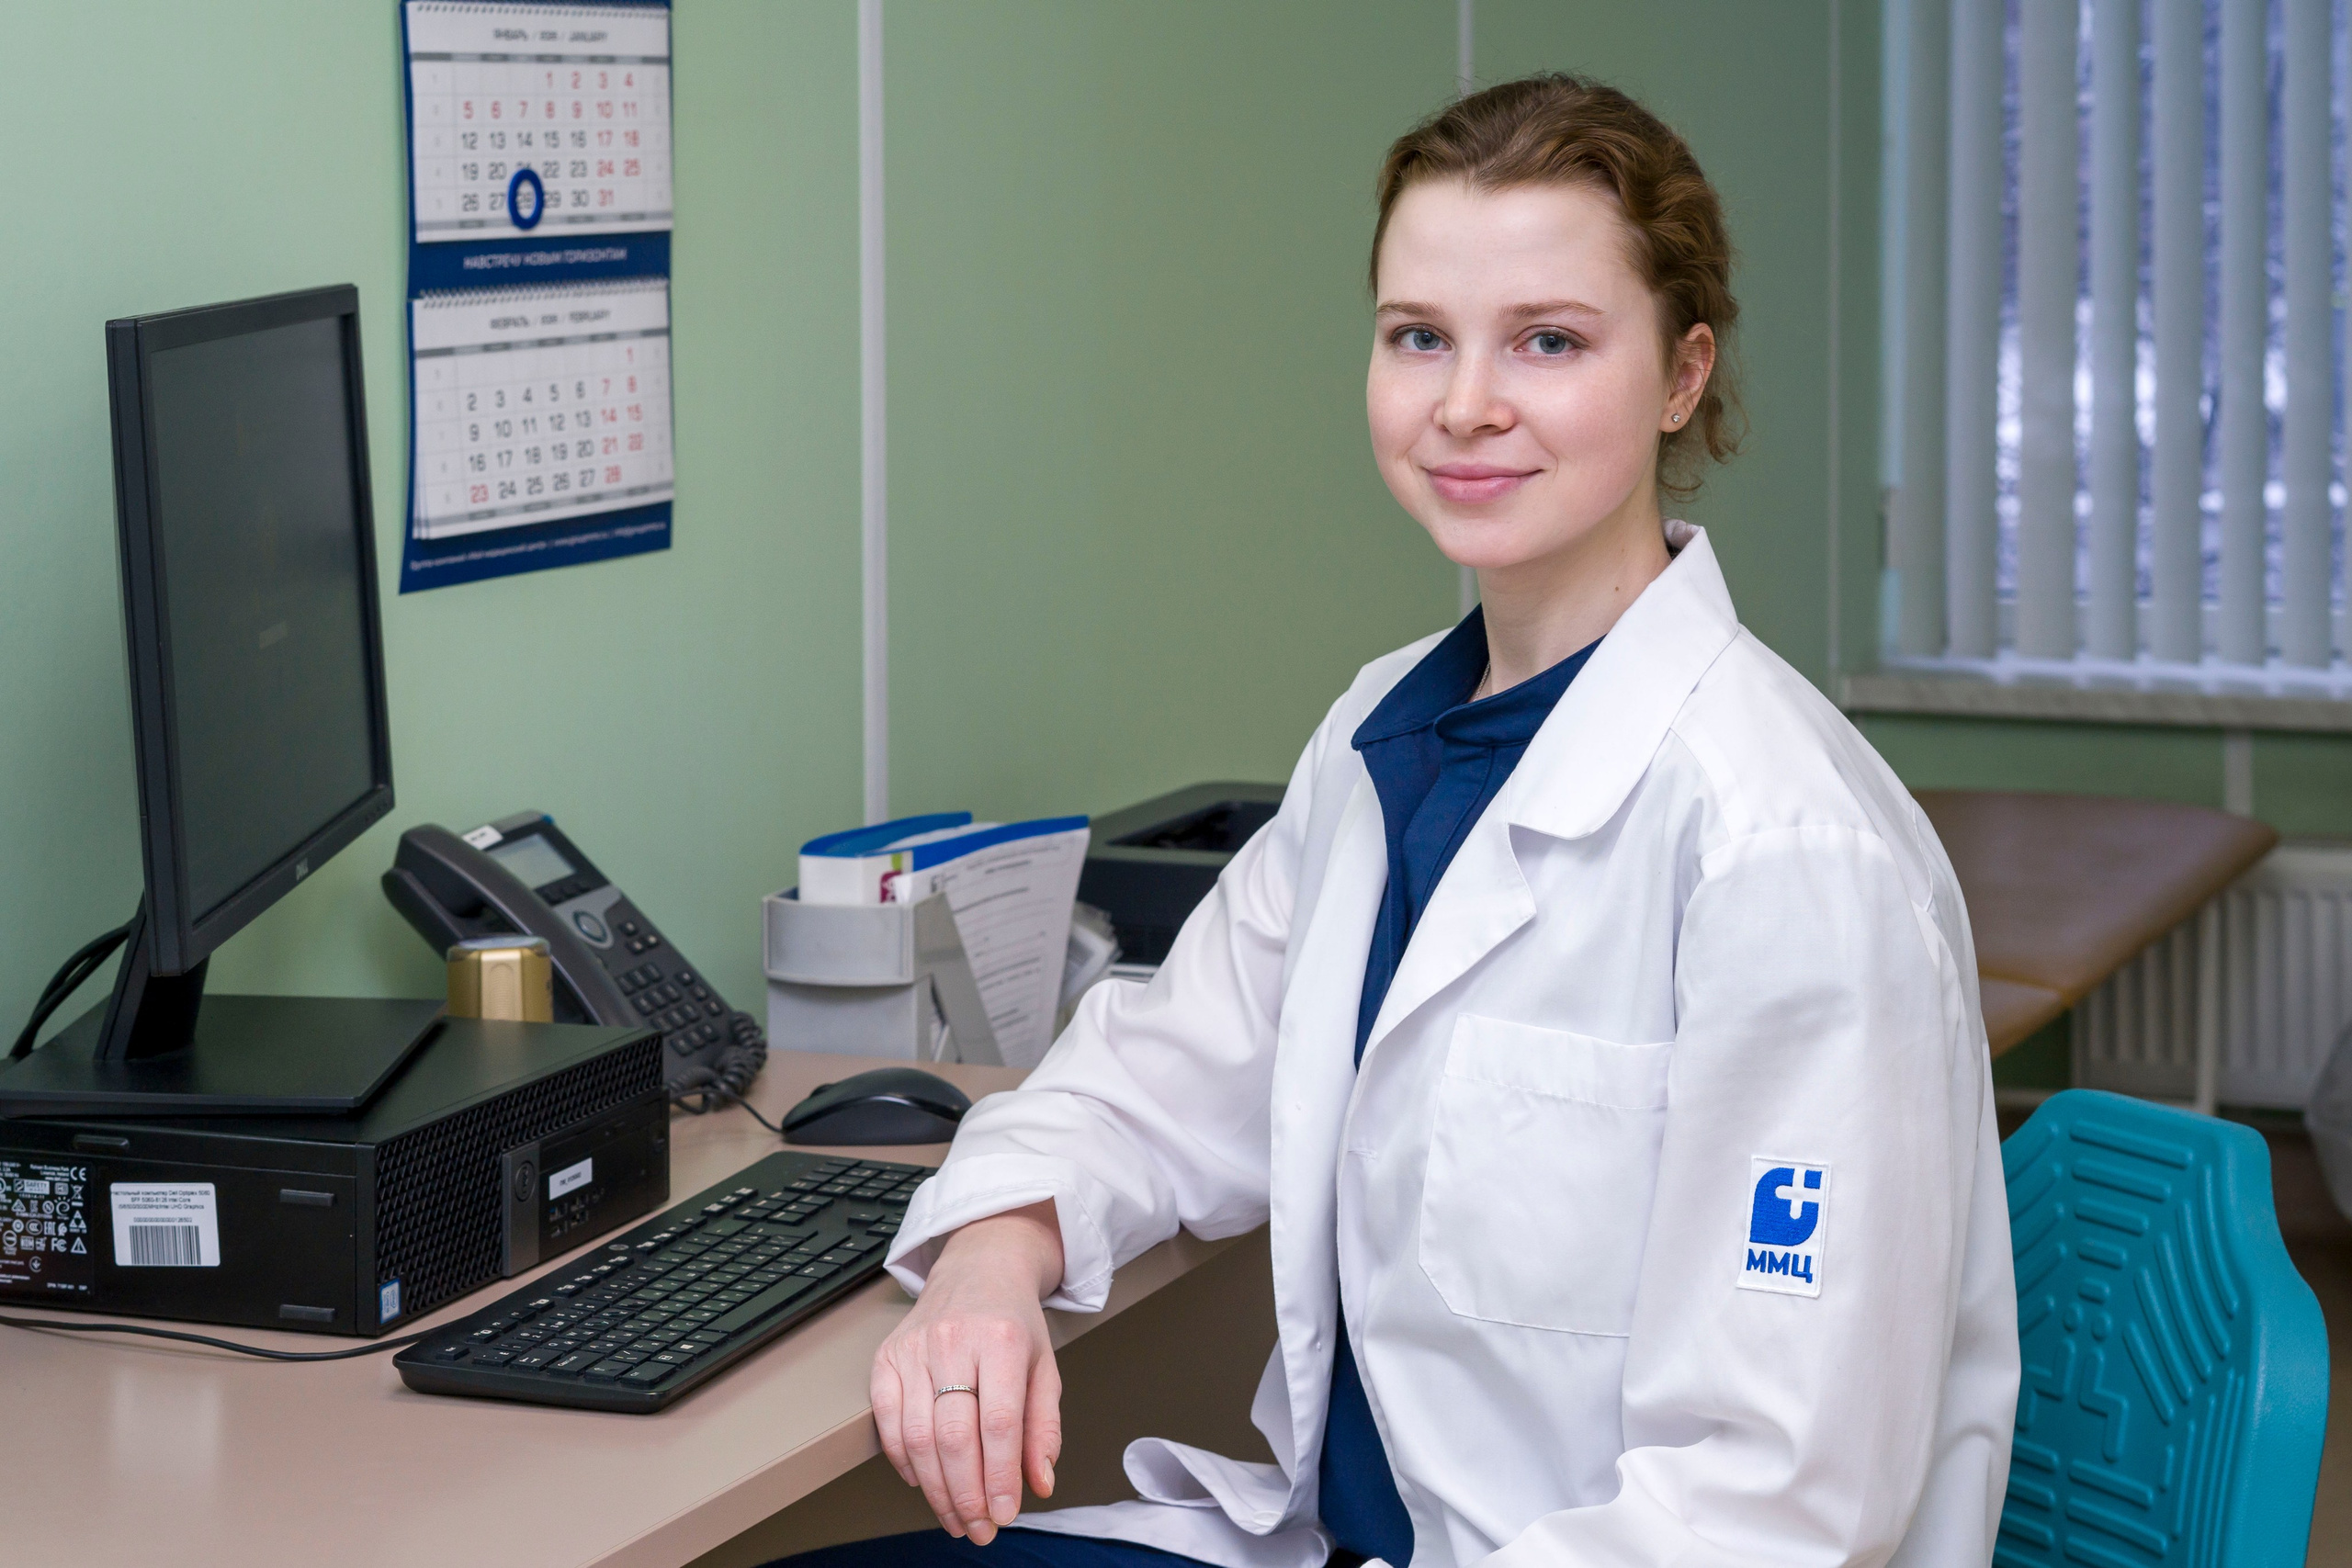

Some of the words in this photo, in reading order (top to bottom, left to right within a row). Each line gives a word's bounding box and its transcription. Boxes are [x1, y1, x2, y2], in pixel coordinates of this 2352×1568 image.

[546, 72, 553, 88] 1
[571, 71, 581, 89] 2
[599, 72, 608, 89] 3
[624, 73, 634, 87] 4
[463, 101, 473, 119] 5
[491, 101, 502, 119] 6
[519, 100, 528, 118] 7
[545, 101, 555, 119] 8
[572, 101, 582, 118] 9
[596, 100, 613, 118] 10
[623, 101, 638, 118] 11
[461, 131, 478, 151] 12
[489, 131, 506, 150] 13
[516, 131, 533, 148] 14
[544, 130, 560, 149] 15
[571, 130, 586, 148] 16
[597, 130, 613, 146] 17
[624, 130, 639, 147] 18
[462, 163, 479, 181] 19
[488, 162, 506, 181] 20
[543, 161, 560, 179] 22
[570, 160, 588, 178] 23
[597, 160, 615, 177] 24
[624, 158, 640, 176] 25
[462, 193, 480, 212] 26
[489, 191, 506, 210] 27
[544, 189, 561, 209] 29
[571, 189, 589, 208] 30
[598, 188, 614, 207] 31
[627, 347, 634, 363] 1
[467, 392, 477, 412] 2
[495, 389, 505, 409] 3
[522, 387, 532, 403] 4
[549, 384, 560, 402] 5
[575, 381, 585, 400] 6
[602, 378, 610, 394] 7
[628, 376, 638, 393] 8
[469, 423, 480, 442] 9
[494, 420, 512, 438] 10
[522, 417, 537, 434] 11
[548, 413, 565, 432] 12
[575, 410, 592, 428] 13
[600, 407, 617, 423] 14
[627, 403, 643, 422] 15
[469, 453, 486, 472] 16
[496, 449, 513, 467] 17
[525, 446, 542, 465] 18
[551, 443, 568, 460] 19
[577, 439, 594, 458] 20
[602, 436, 618, 455] 21
[628, 433, 644, 451] 22
[469, 484, 489, 503] 23
[498, 480, 517, 500] 24
[526, 476, 544, 495] 25
[553, 472, 570, 491] 26
[579, 468, 595, 488] 27
[605, 465, 621, 484] 28
[1746, 1248, 1813, 1283] ММЦ
